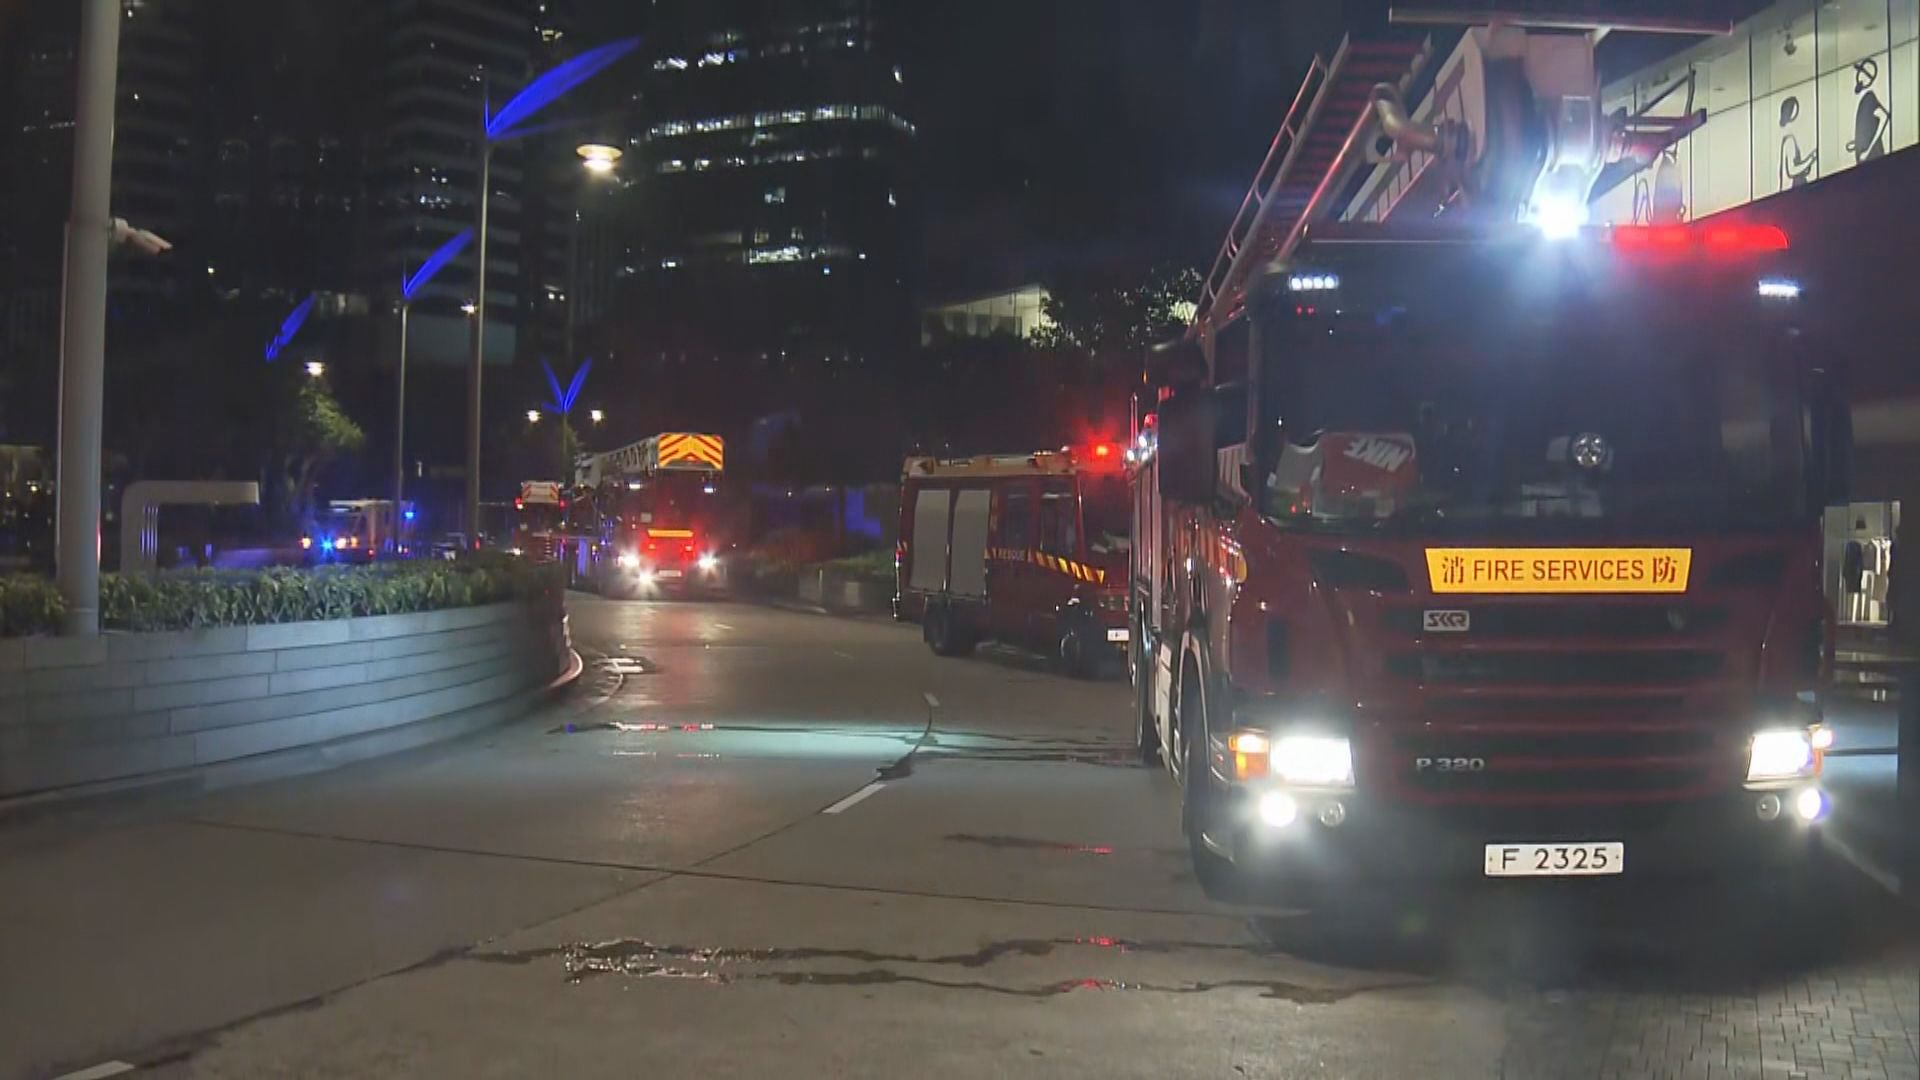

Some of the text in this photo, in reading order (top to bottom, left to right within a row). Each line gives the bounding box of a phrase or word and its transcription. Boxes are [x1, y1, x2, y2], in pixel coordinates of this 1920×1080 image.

[1343, 437, 1411, 473] NIKE
[1441, 556, 1677, 585] 消 FIRE SERVICES 防
[1416, 757, 1485, 772] P 320
[1501, 846, 1608, 870] F 2325
